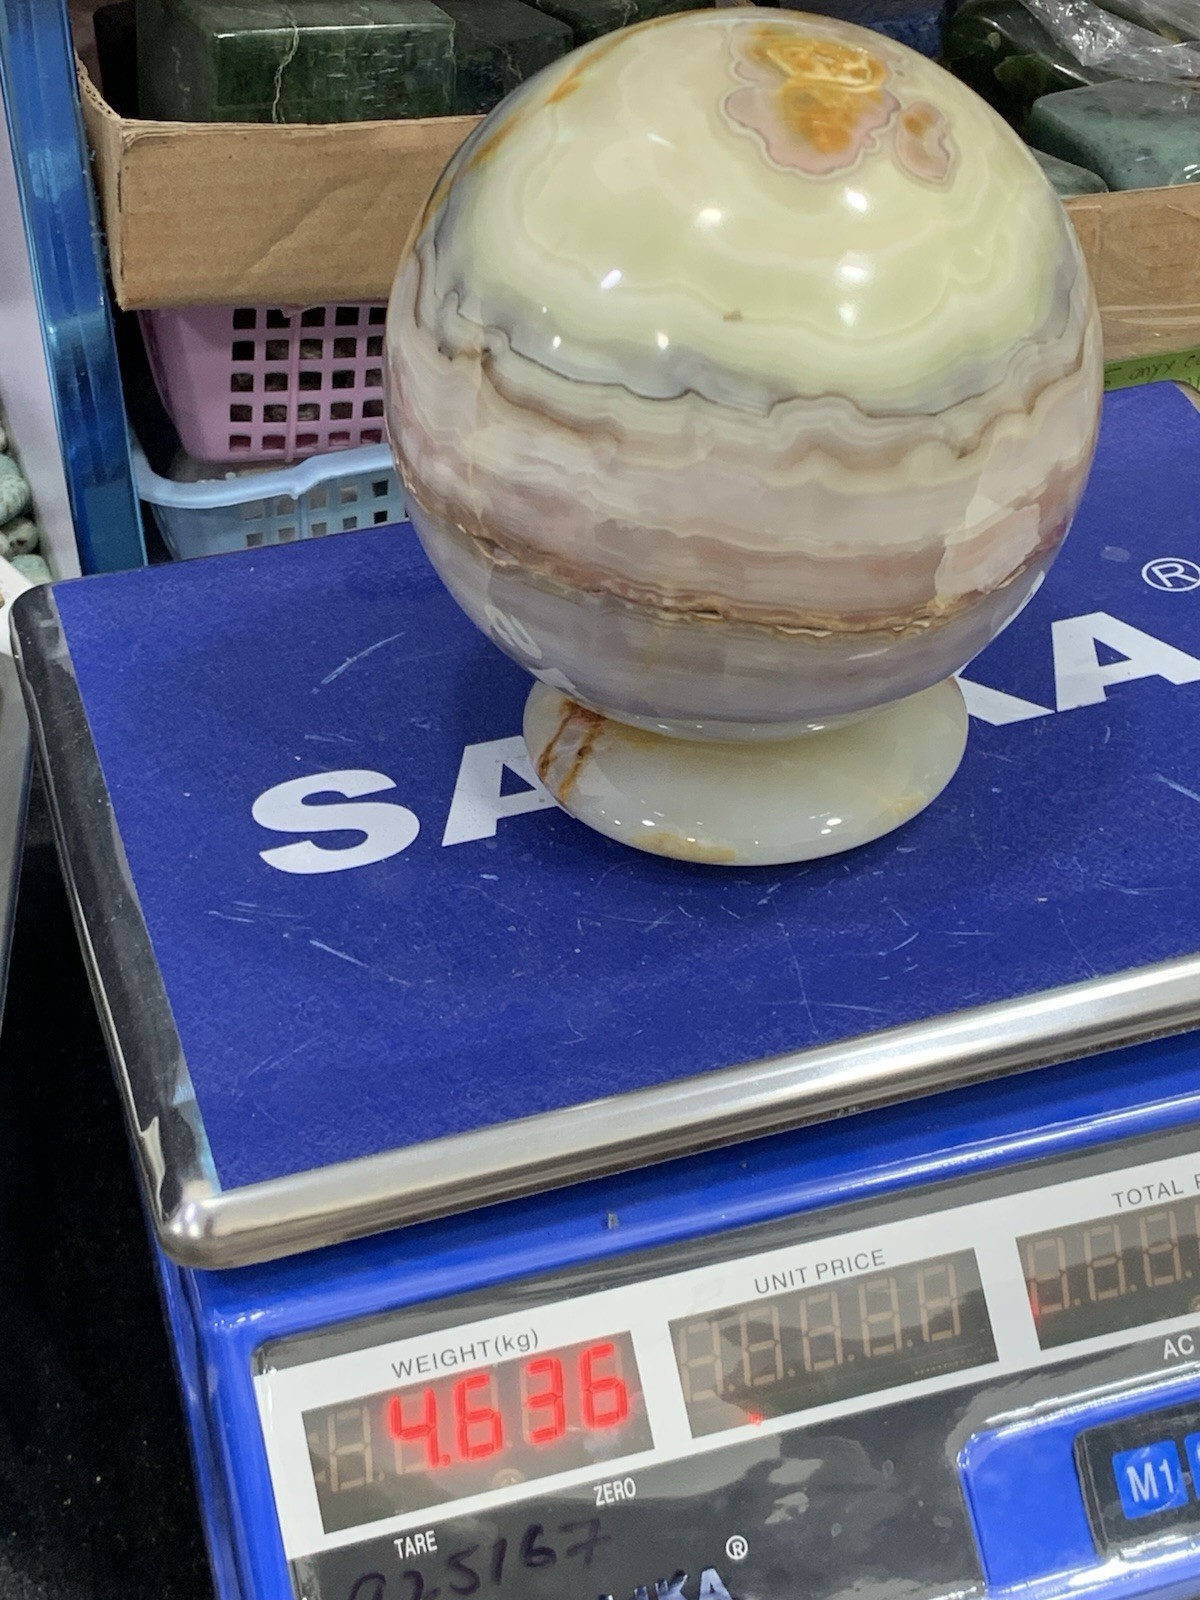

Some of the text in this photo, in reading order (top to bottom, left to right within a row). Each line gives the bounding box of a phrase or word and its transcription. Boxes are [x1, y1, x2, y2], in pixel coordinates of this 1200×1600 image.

[1111, 1179, 1184, 1208] TOTAL
[754, 1249, 886, 1294] UNIT PRICE
[391, 1328, 539, 1378] WEIGHT(kg)
[1163, 1334, 1195, 1360] AC
[388, 1341, 630, 1469] 4.636
[593, 1477, 637, 1506] ZERO
[1126, 1458, 1175, 1503] M1
[393, 1530, 438, 1559] TARE
